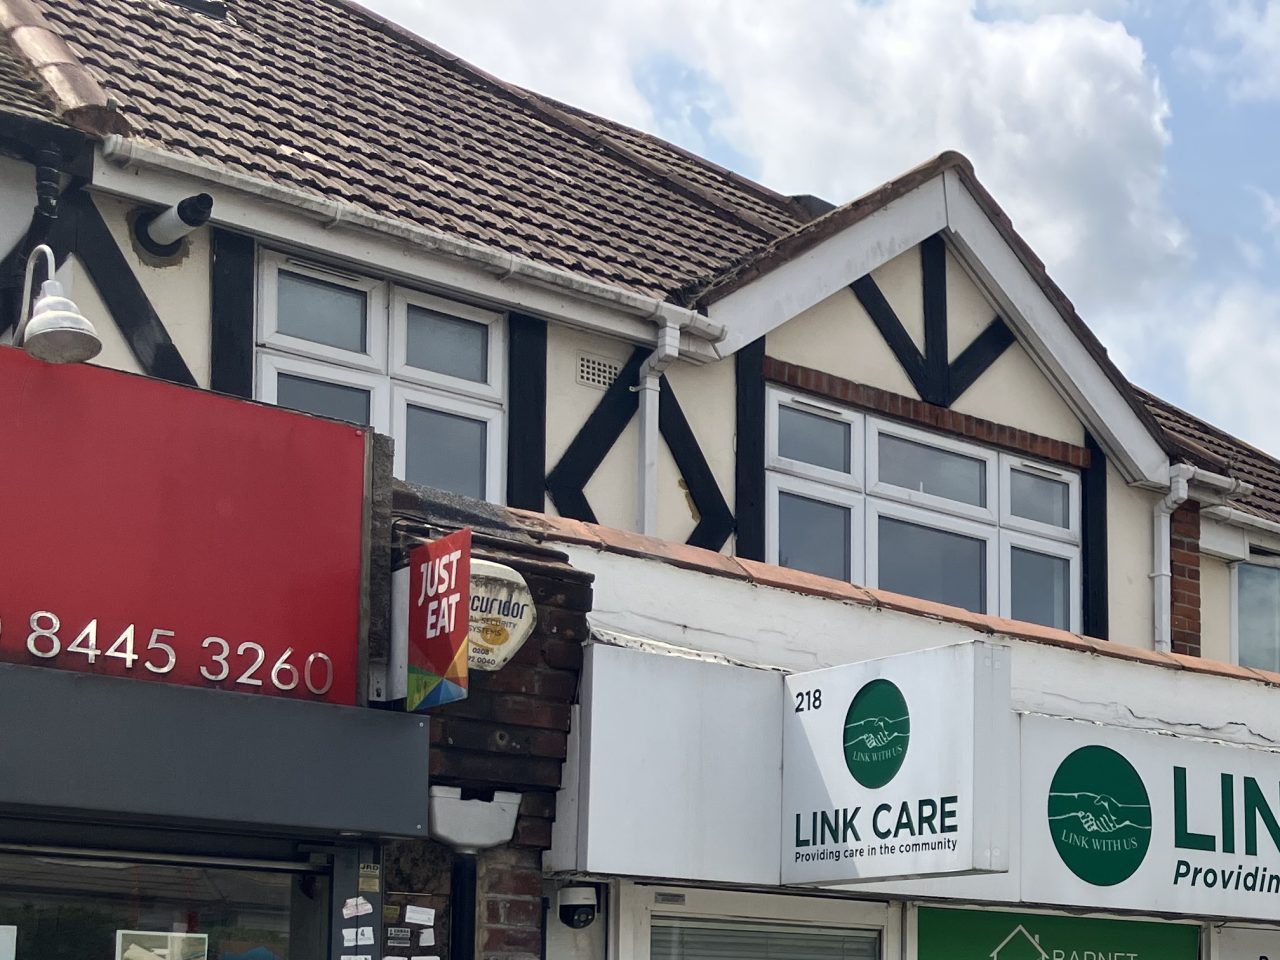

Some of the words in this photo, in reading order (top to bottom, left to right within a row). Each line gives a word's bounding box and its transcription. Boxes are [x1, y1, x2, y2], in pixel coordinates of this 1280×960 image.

[418, 549, 461, 607] JUST
[426, 592, 460, 639] EAT
[469, 593, 529, 619] curidor
[26, 610, 177, 673] 8445
[200, 637, 333, 695] 3260
[795, 688, 822, 713] 218
[852, 750, 871, 762] LINK
[871, 750, 892, 762] WITH
[892, 744, 903, 758] US
[795, 806, 861, 848] LINK
[872, 795, 958, 840] CARE
[795, 847, 841, 863] Providing
[843, 847, 864, 859] care
[867, 845, 877, 857] in
[879, 843, 895, 855] the
[898, 838, 958, 854] community
[1061, 829, 1089, 849] LINK
[1092, 838, 1122, 851] WITH
[1123, 836, 1138, 850] US
